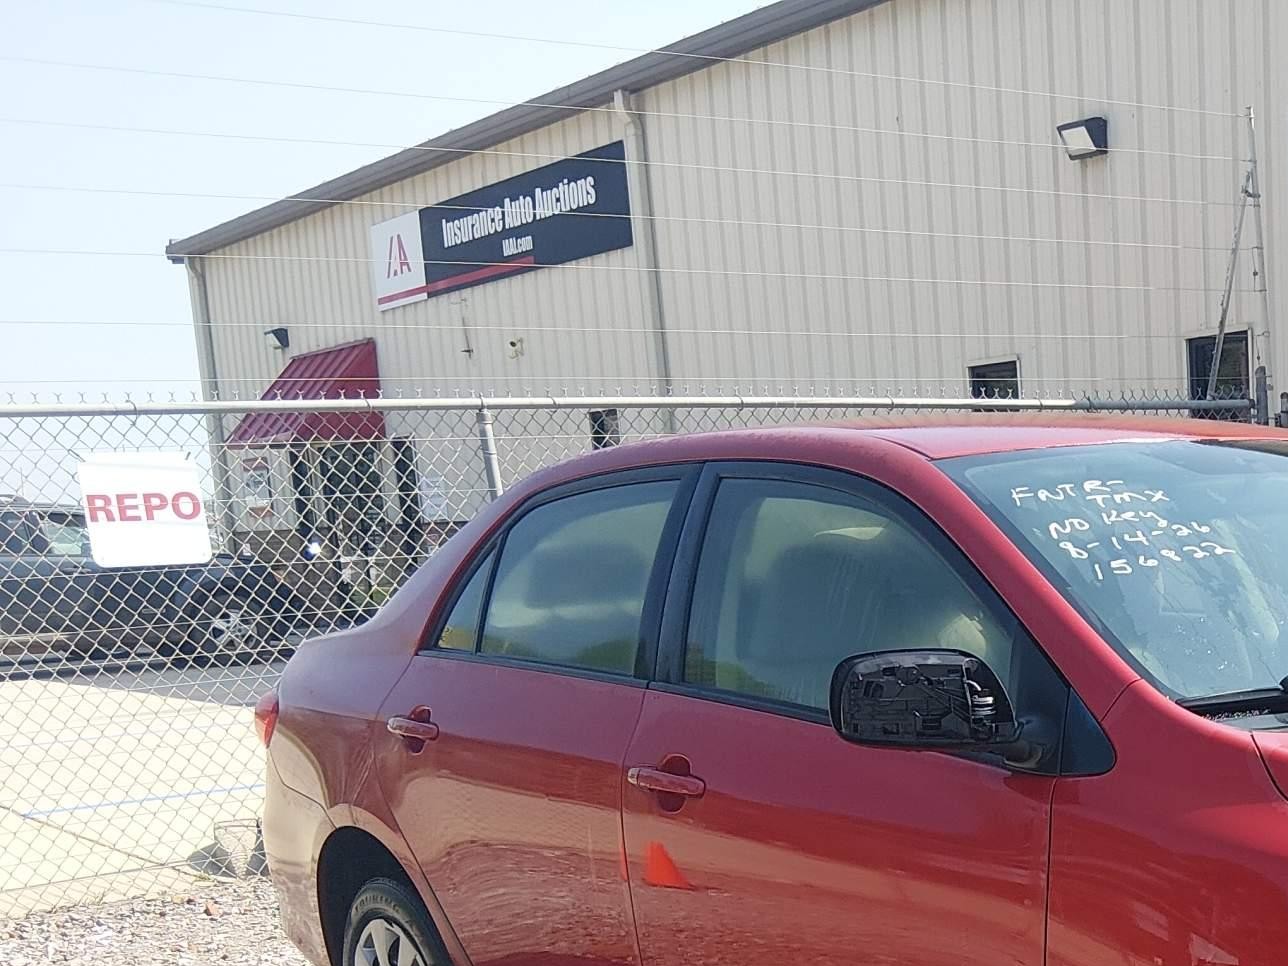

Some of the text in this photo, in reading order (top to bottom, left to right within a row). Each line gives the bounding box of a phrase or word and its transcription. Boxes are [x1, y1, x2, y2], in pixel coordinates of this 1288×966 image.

[442, 176, 596, 248] Insurance Auto Auctions
[86, 491, 201, 523] REPO
